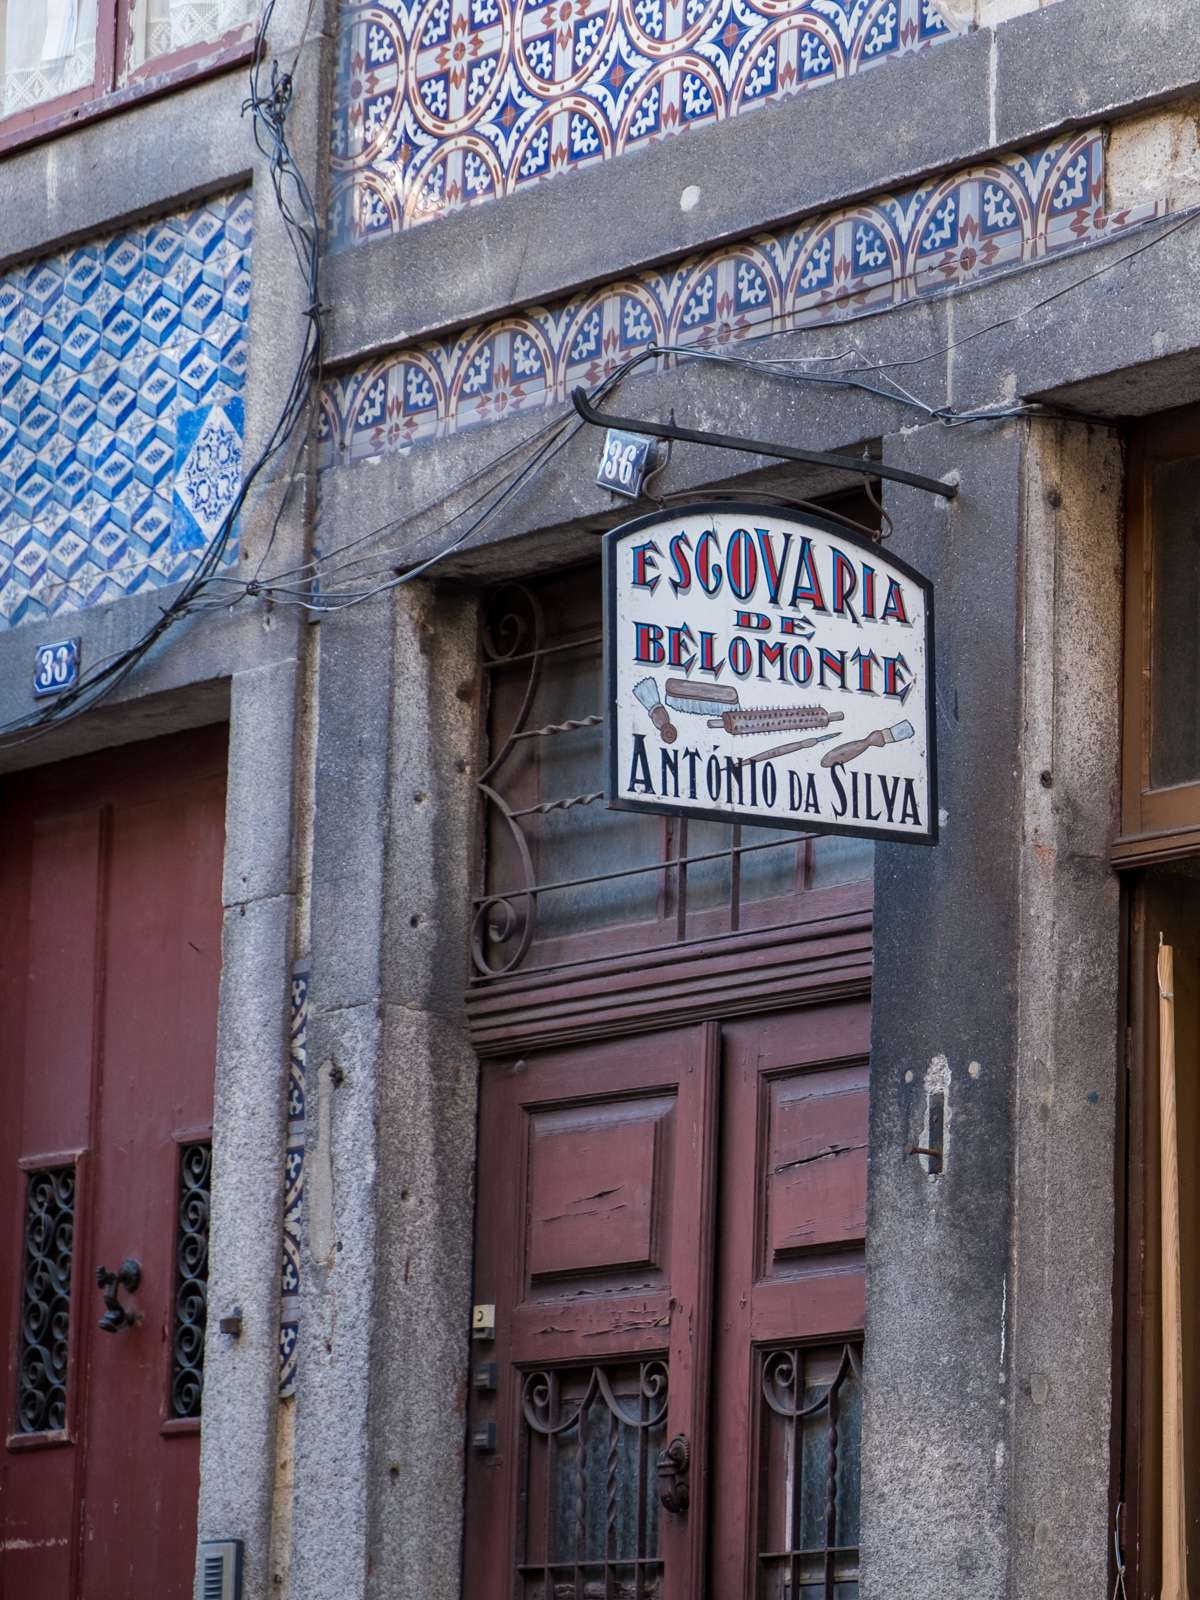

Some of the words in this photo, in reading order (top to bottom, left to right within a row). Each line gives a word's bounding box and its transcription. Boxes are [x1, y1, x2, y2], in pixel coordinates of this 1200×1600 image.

[604, 440, 637, 484] 36
[630, 527, 913, 625] ESCOVARIA
[731, 609, 817, 642] DE
[631, 620, 916, 706] BELOMONTE
[788, 768, 822, 816] DA
[828, 761, 923, 828] SILVA
